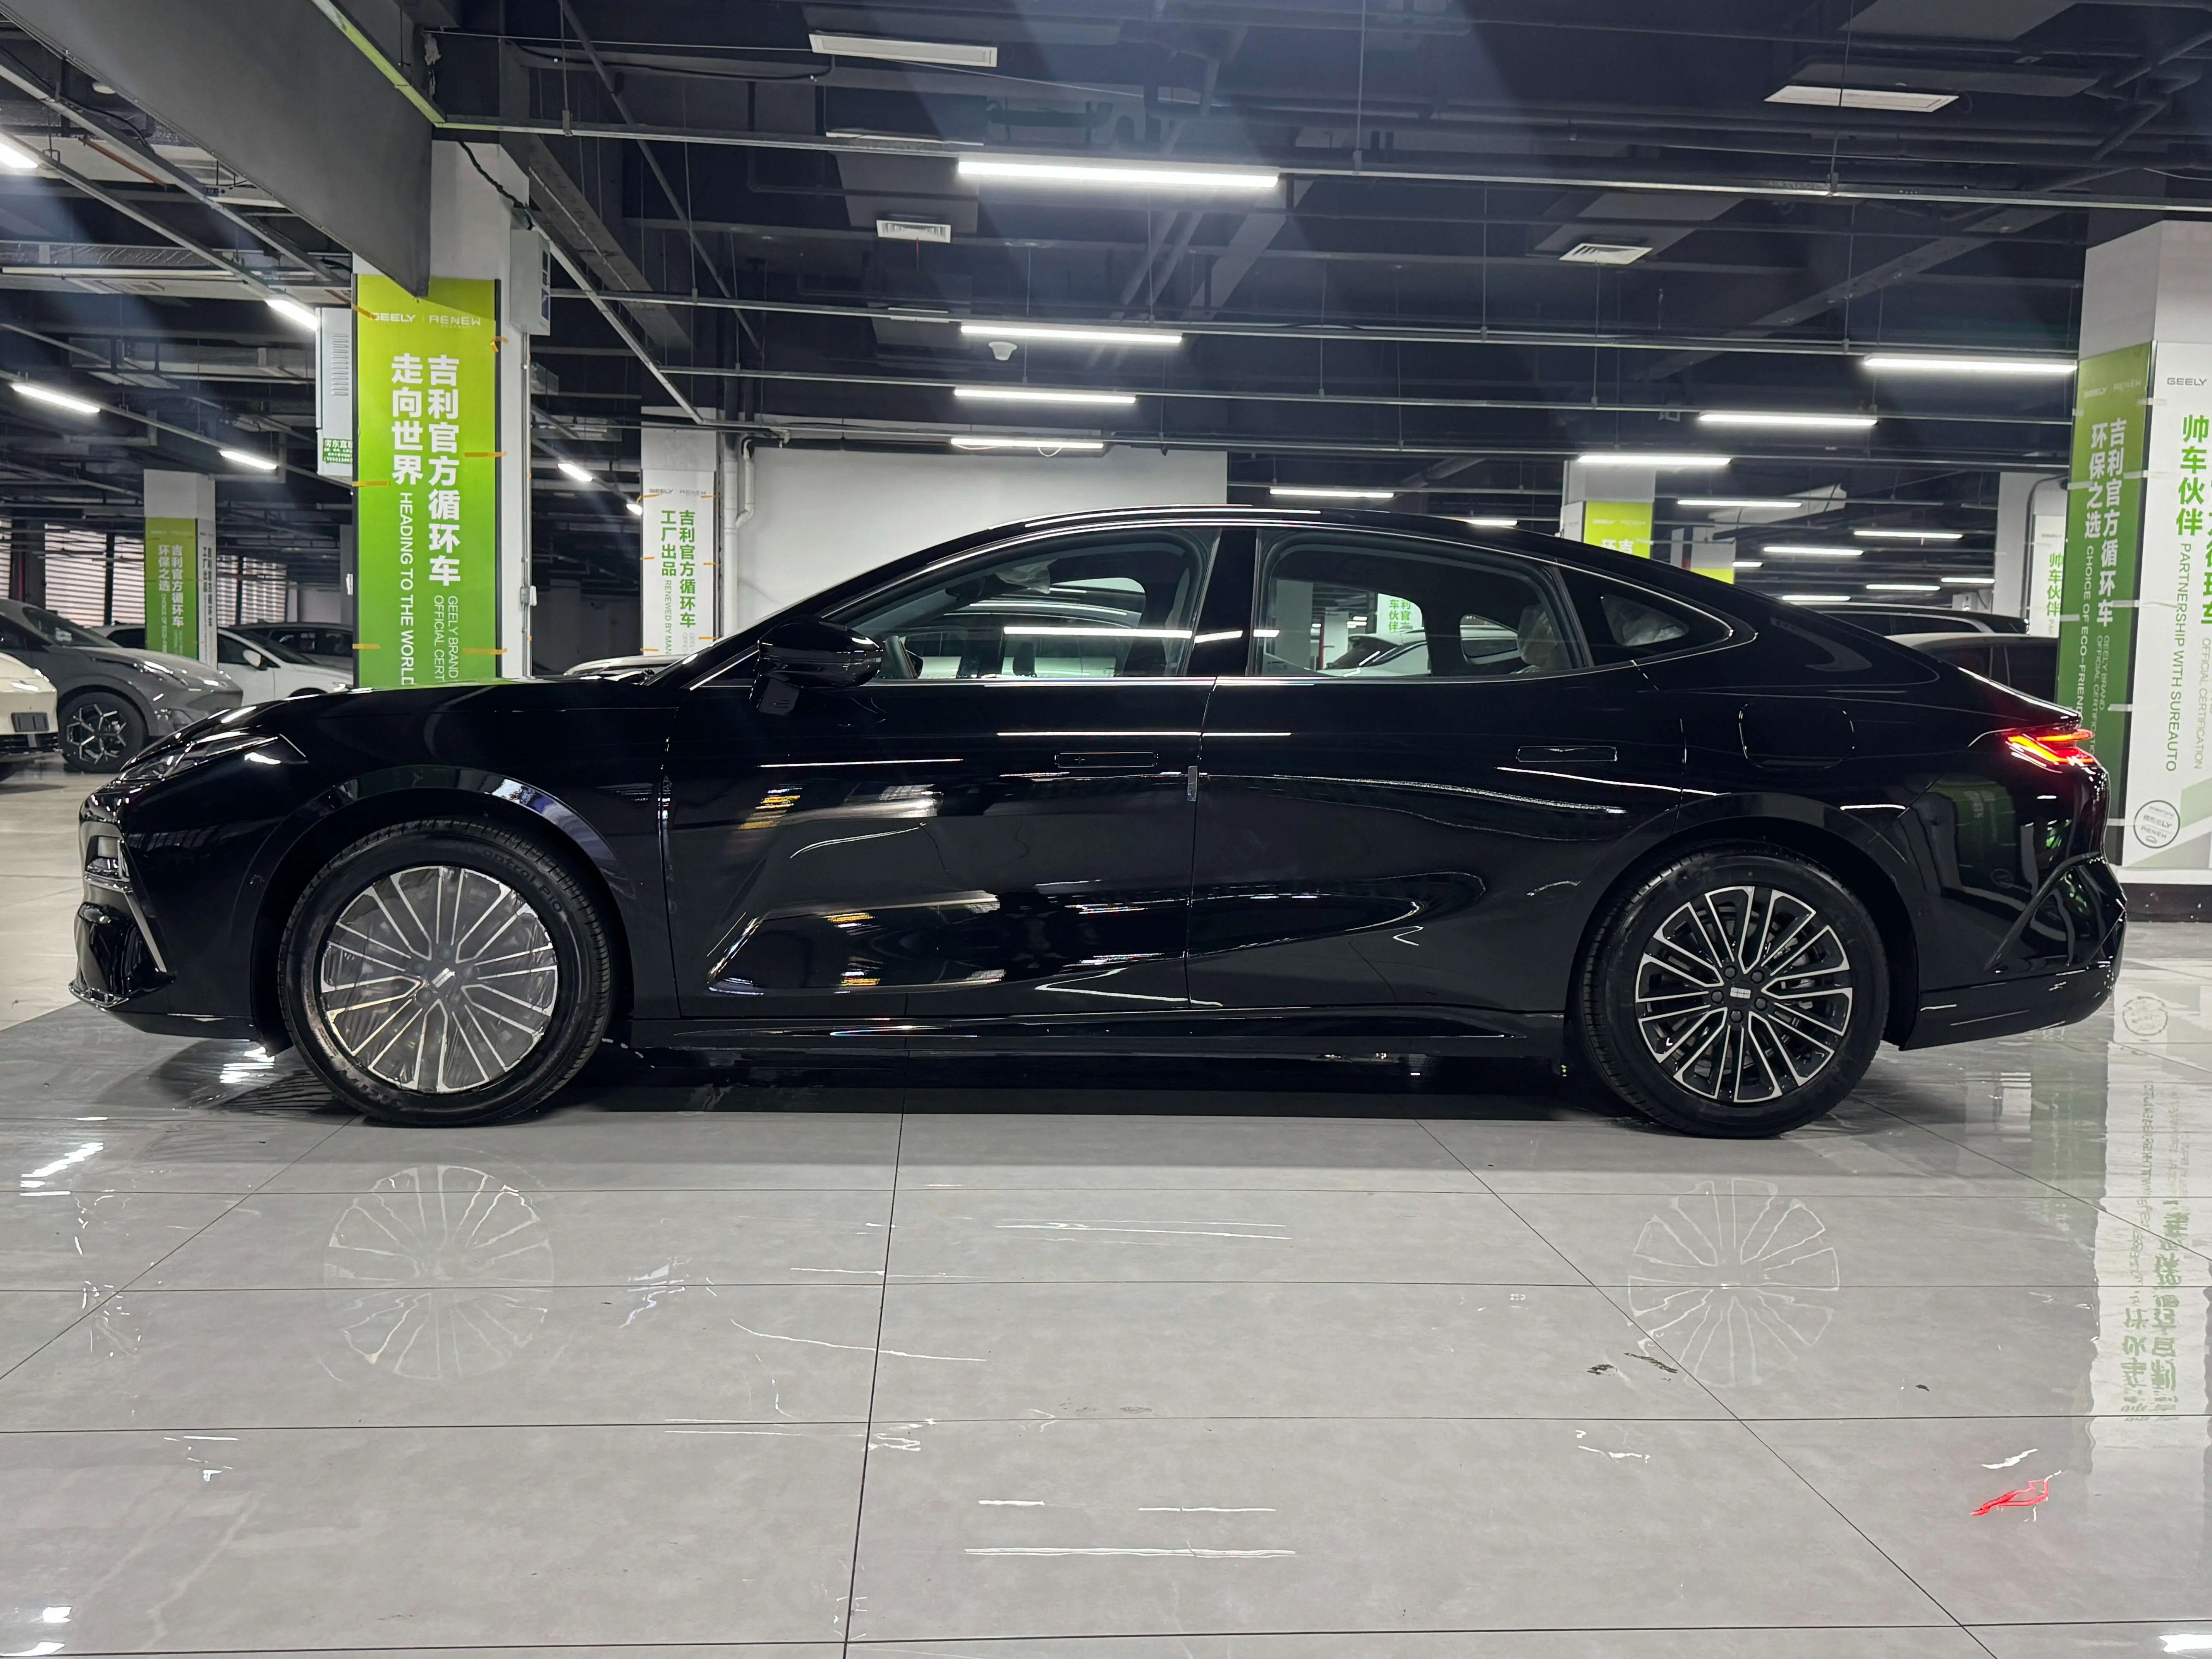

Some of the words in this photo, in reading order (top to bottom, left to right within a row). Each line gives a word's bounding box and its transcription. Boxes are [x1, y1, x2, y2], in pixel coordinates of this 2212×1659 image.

[370, 312, 416, 322] GEELY
[2167, 378, 2207, 386] GEELY
[391, 353, 423, 485] 走向世界
[428, 354, 461, 586] 吉利官方循环车
[2084, 422, 2108, 539] 环保之选
[2176, 414, 2209, 536] 帅车伙伴
[400, 493, 413, 565] HEADING
[661, 510, 677, 576] 工厂出品
[2097, 417, 2127, 627] 吉利官方循环车
[400, 568, 414, 591] TO
[680, 510, 696, 628] 吉利官方循环车
[2047, 553, 2063, 616] 帅车伙伴
[2083, 545, 2094, 601] CHOICE
[2174, 543, 2191, 647] PARTNERSHIP
[400, 594, 414, 626] THE
[434, 595, 445, 647] OFFICIAL
[448, 596, 459, 635] GEELY
[665, 623, 672, 634] BY
[2082, 603, 2090, 622] OF
[448, 637, 459, 678] BRAND
[2171, 650, 2184, 687] WITH
[2200, 638, 2211, 686] OFFICIAL
[2099, 673, 2107, 710] BRAND
[2166, 691, 2181, 771] SUREAUTO
[2194, 688, 2208, 769] CERTIFICATION
